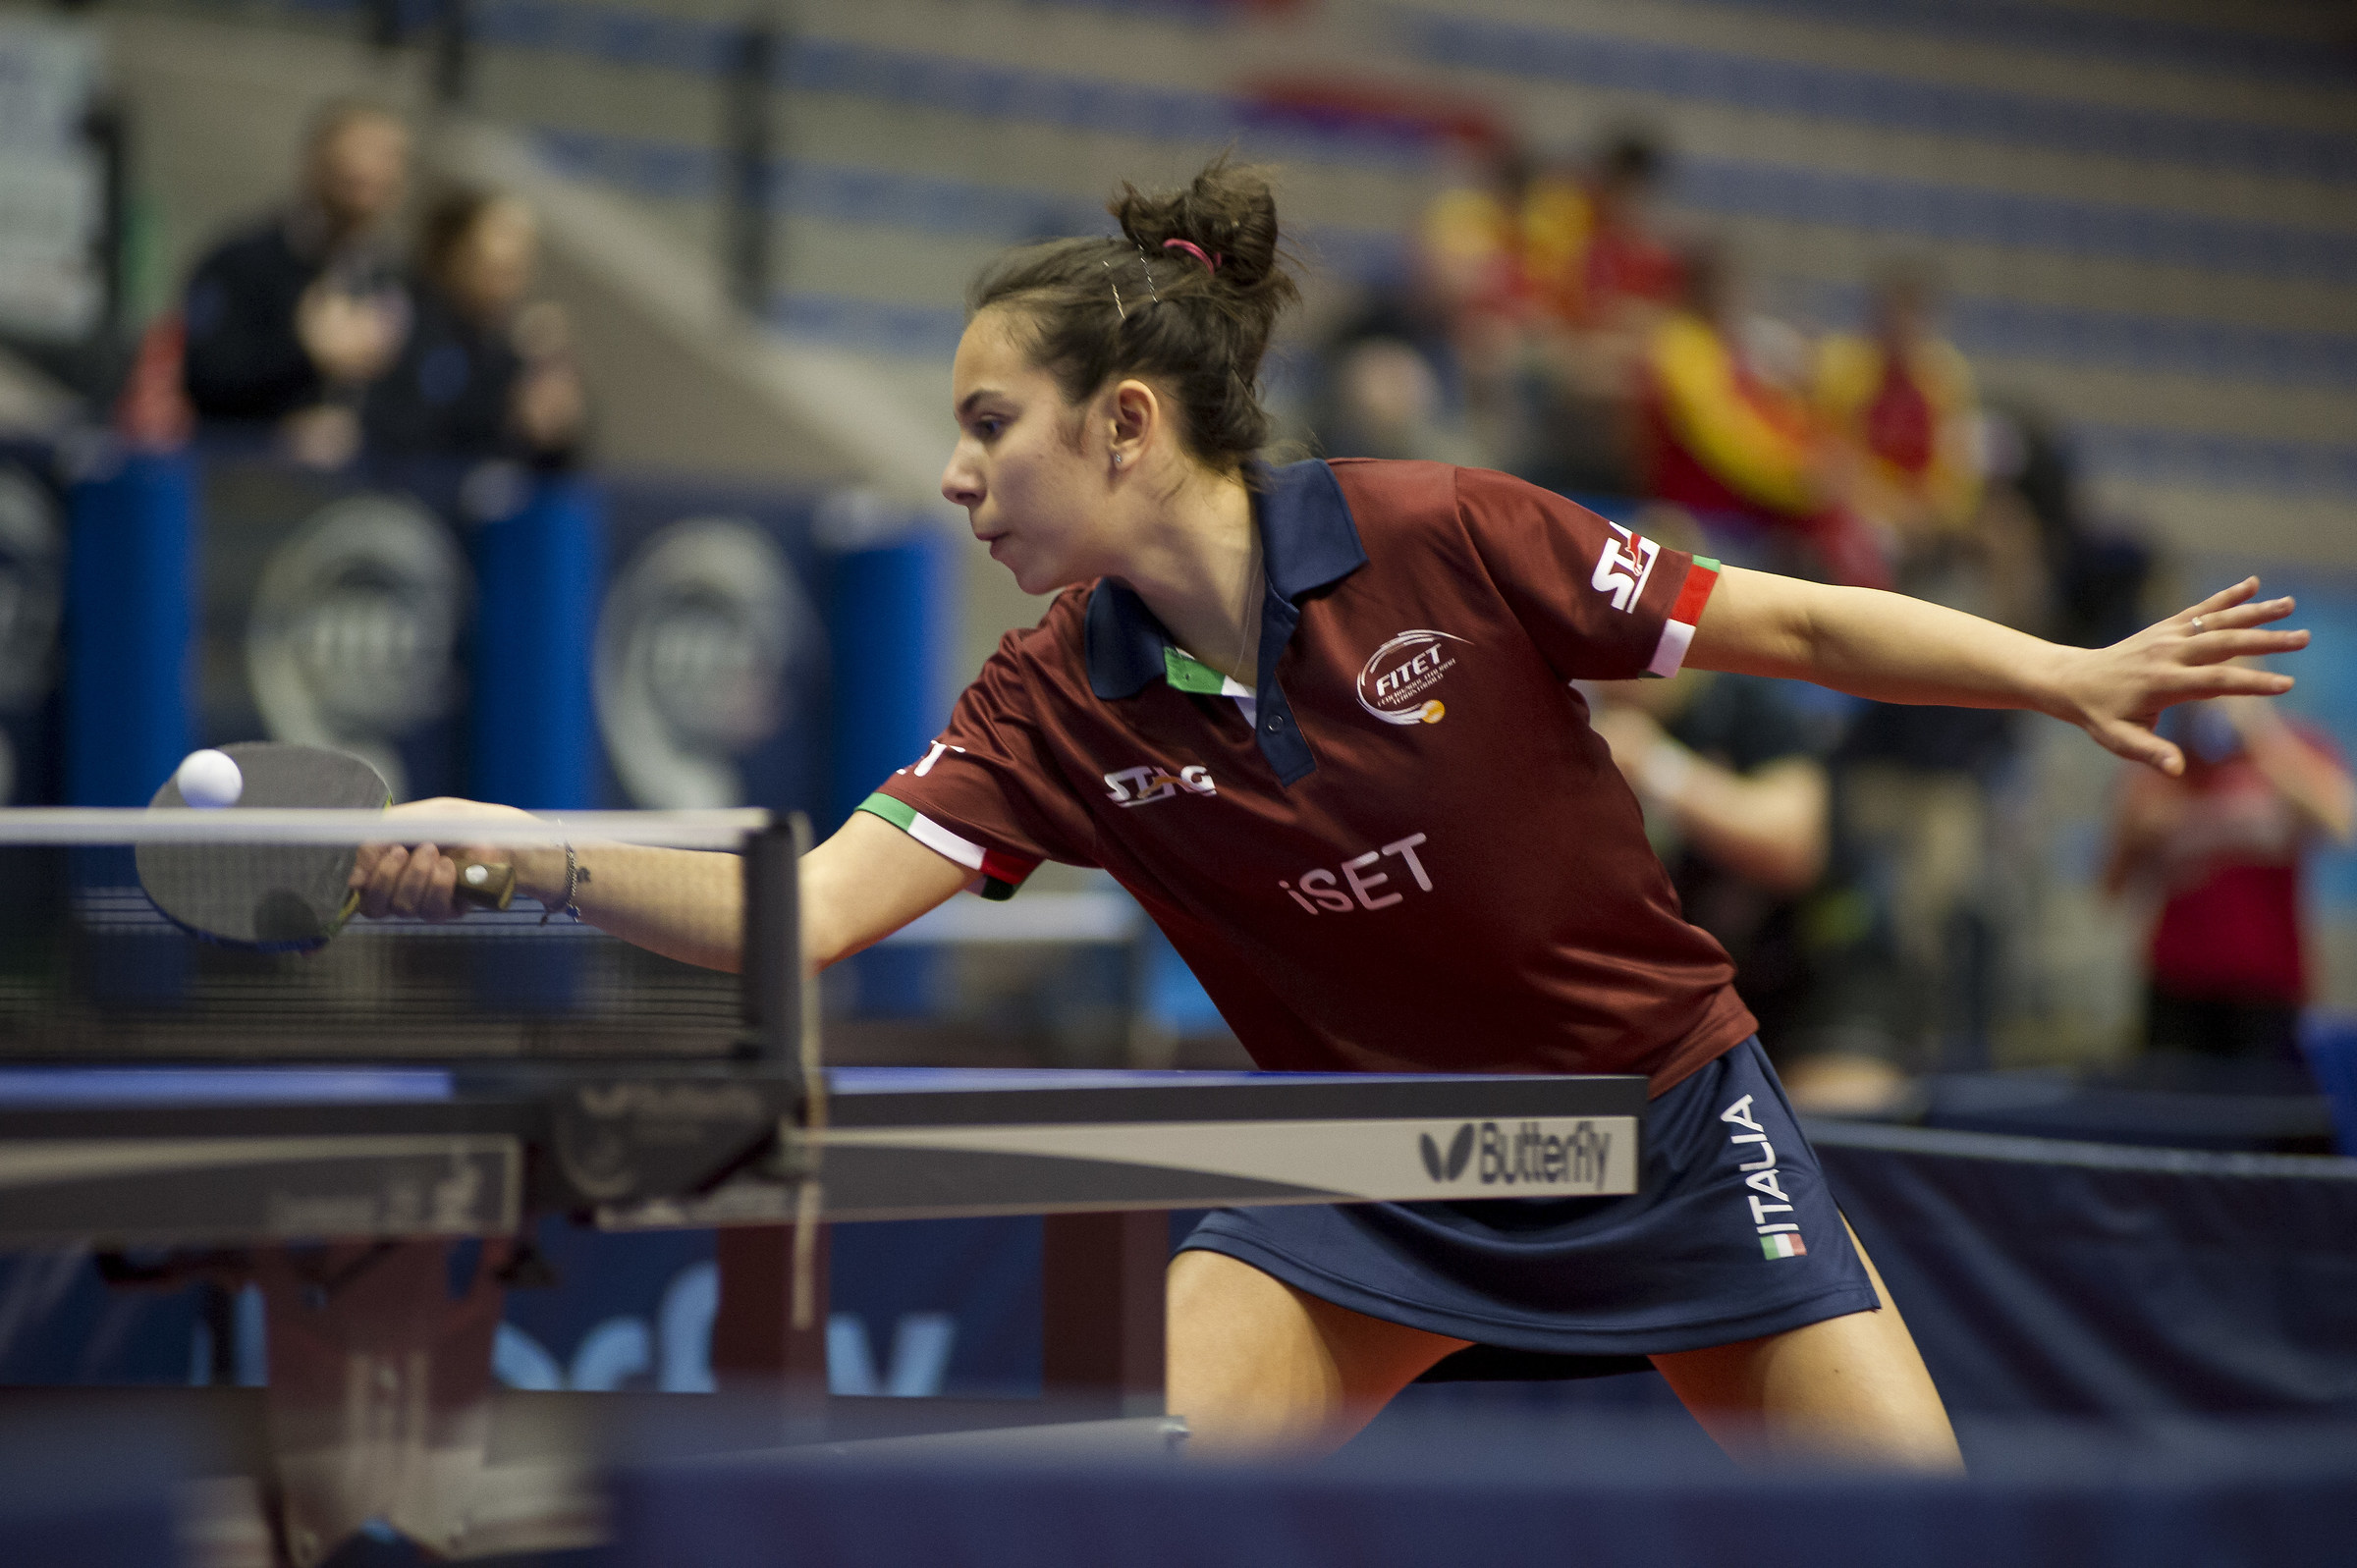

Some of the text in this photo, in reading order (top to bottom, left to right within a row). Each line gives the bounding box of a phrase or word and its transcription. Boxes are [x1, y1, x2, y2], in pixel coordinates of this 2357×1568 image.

[1376, 643, 1442, 697] FITET
[1279, 833, 1433, 915] iSET
[1480, 1121, 1612, 1192] Butterfly
[1721, 1094, 1799, 1234] ITALIA
